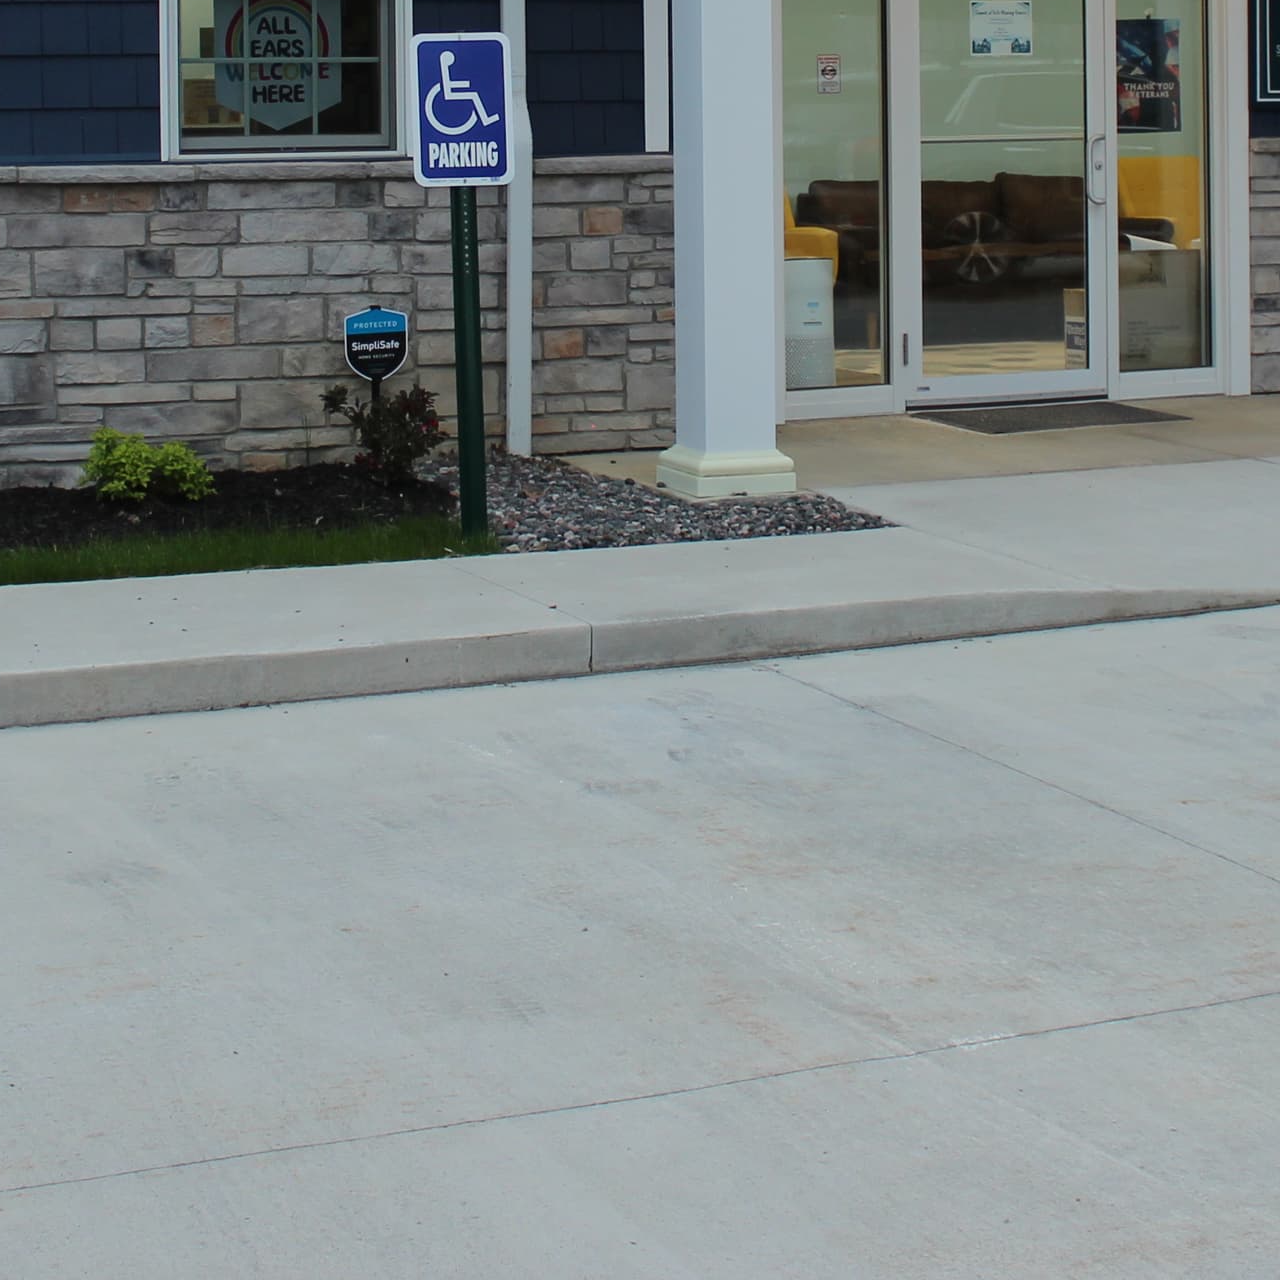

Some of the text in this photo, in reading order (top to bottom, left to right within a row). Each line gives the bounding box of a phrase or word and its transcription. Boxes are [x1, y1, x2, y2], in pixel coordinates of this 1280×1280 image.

[257, 16, 296, 35] ALL
[250, 39, 305, 58] EARS
[225, 62, 330, 82] WELCOME
[252, 84, 305, 104] HERE
[1124, 82, 1175, 91] THANK YOU
[428, 141, 499, 168] PARKING
[353, 320, 398, 329] PROTECTED
[351, 340, 400, 352] SimpliSafe
